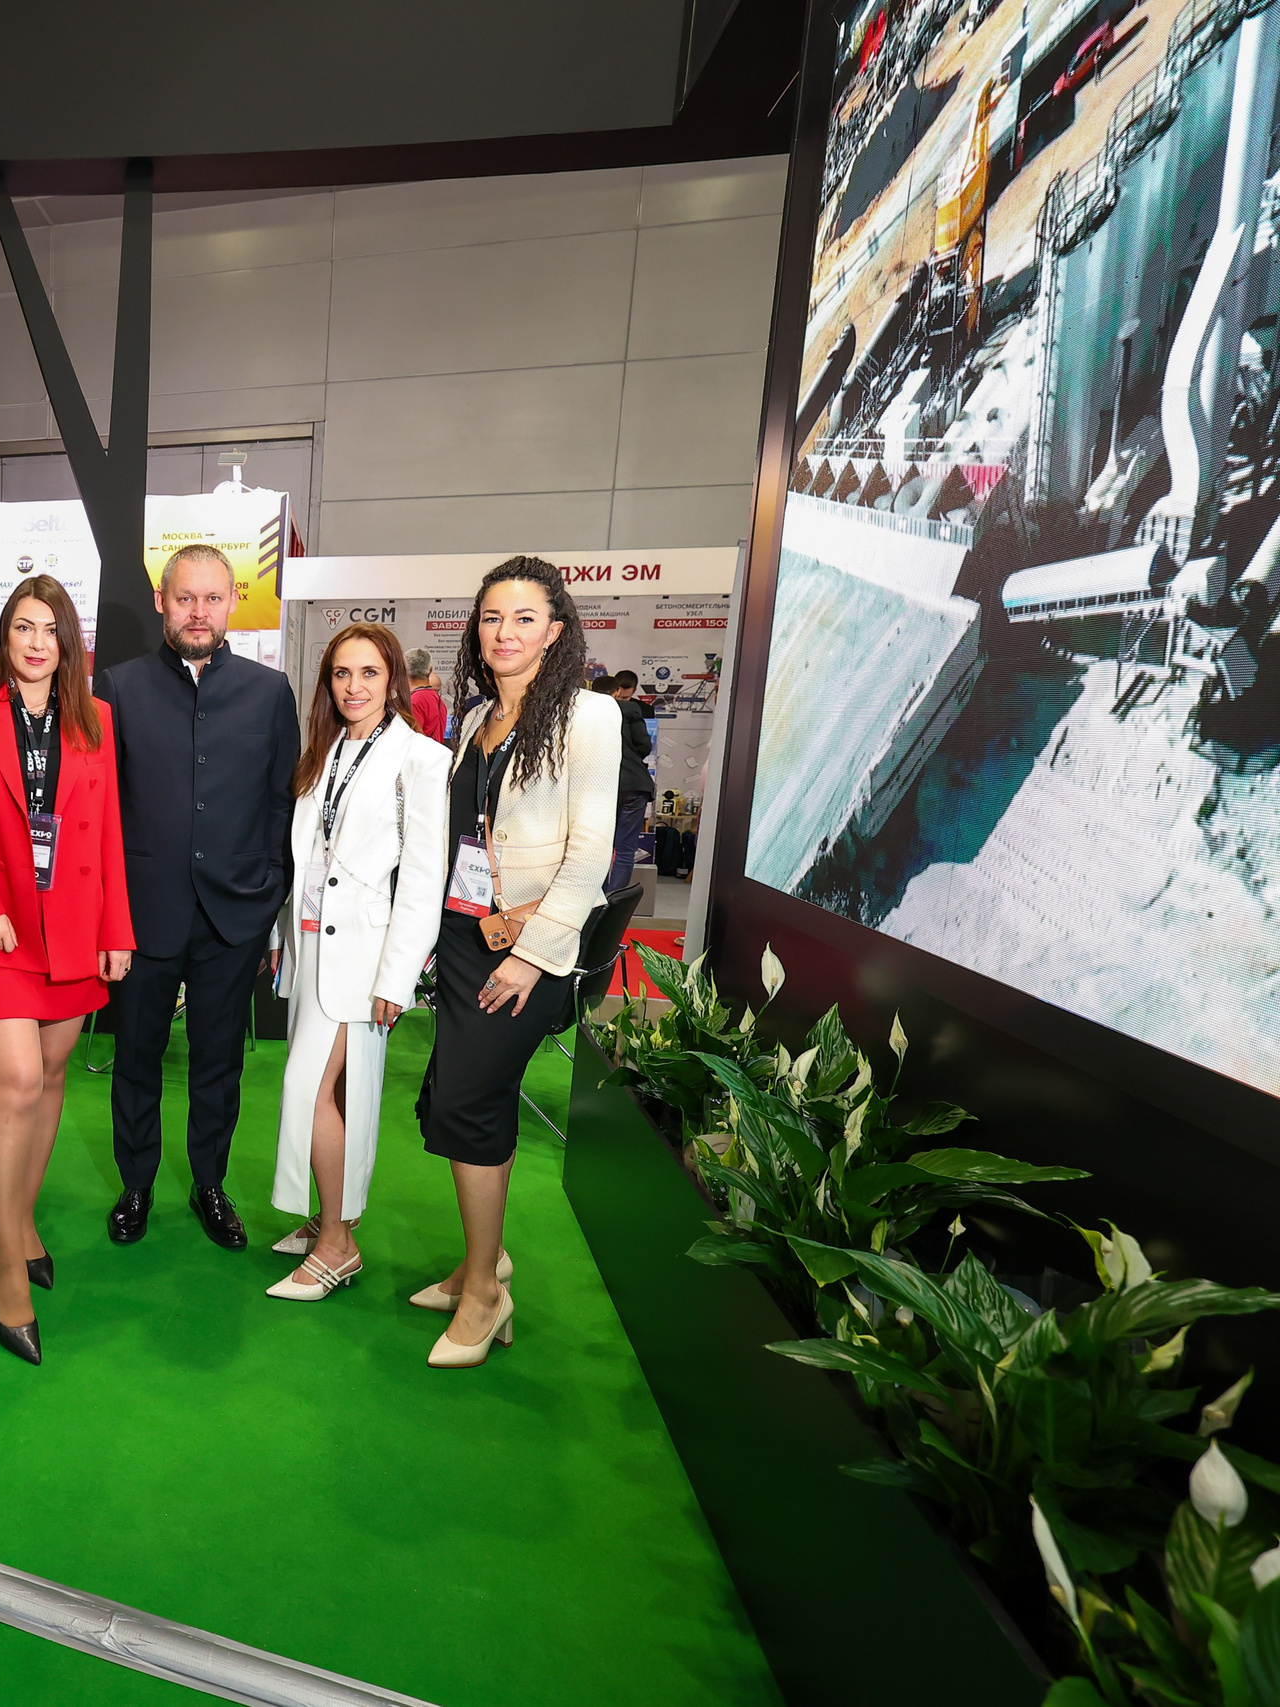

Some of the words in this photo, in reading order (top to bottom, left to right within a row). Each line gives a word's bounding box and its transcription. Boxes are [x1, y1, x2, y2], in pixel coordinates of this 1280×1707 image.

[162, 532, 203, 541] МОСКВА
[621, 564, 662, 582] ЭМ
[60, 580, 84, 588] iesel
[349, 607, 396, 623] CGM
[431, 622, 467, 630] ЗАВОД
[657, 619, 702, 628] CGMMIX
